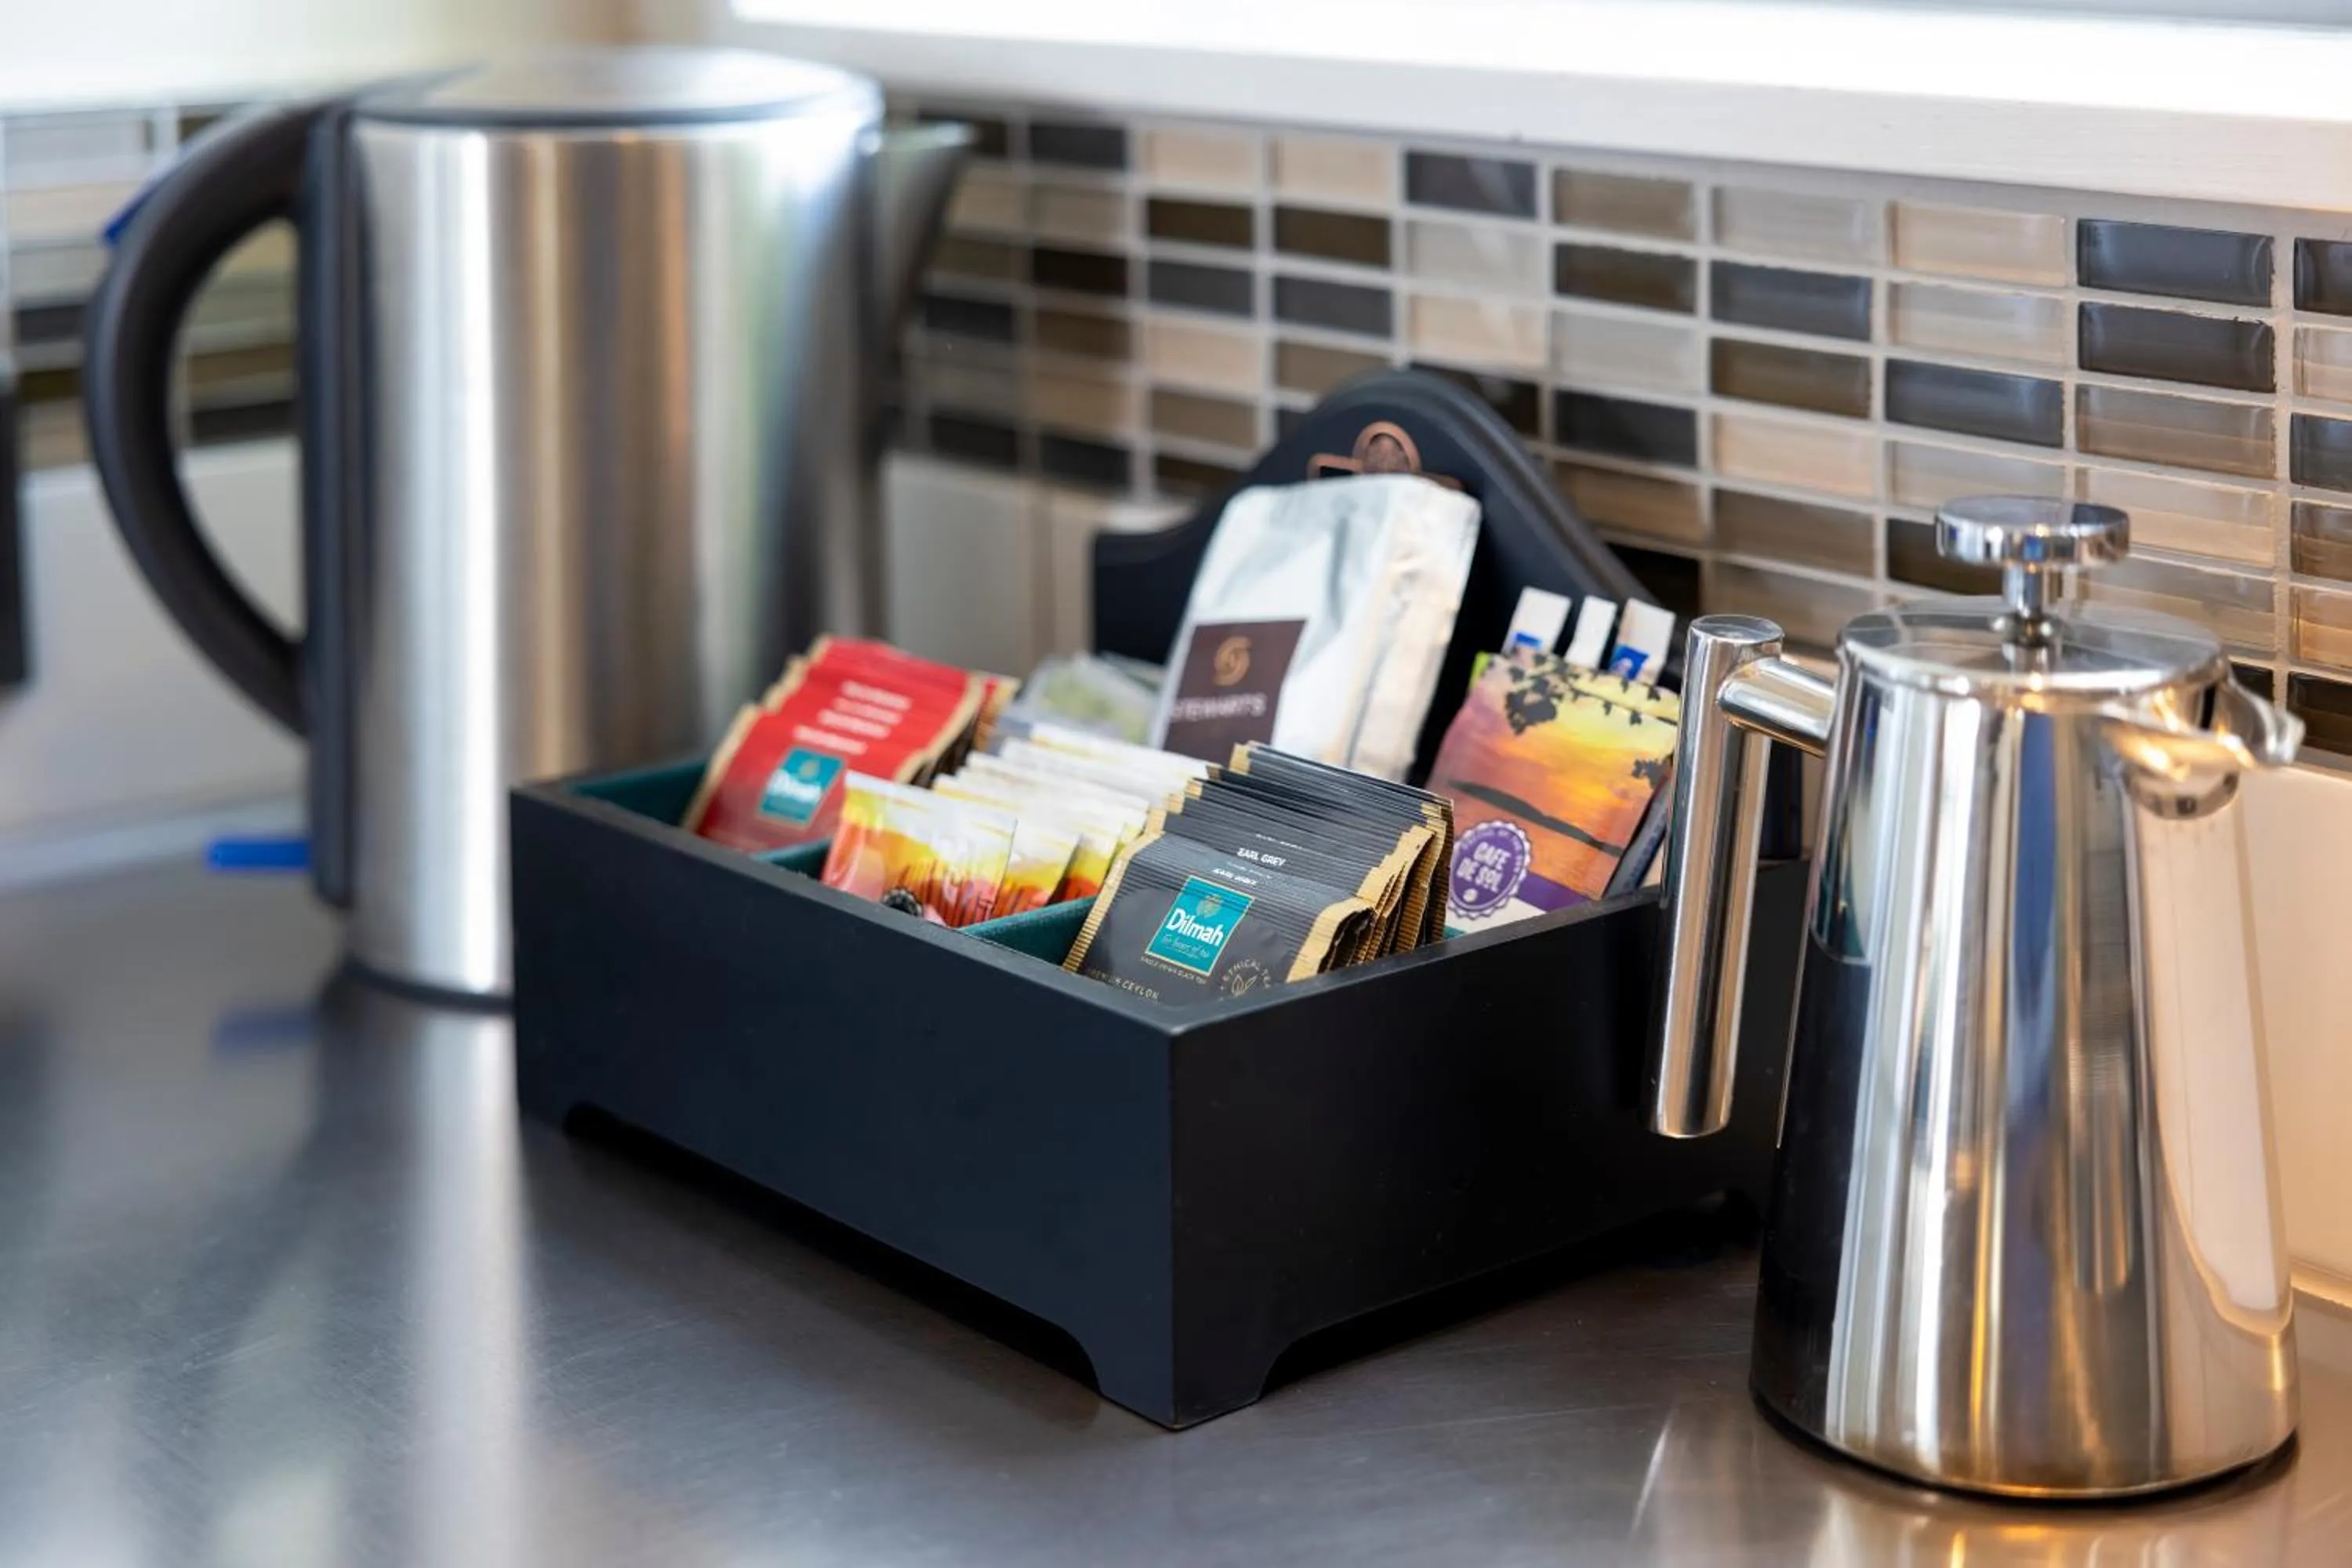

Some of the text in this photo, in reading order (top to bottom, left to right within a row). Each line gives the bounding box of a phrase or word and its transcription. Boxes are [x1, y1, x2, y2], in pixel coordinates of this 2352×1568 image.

[1237, 848, 1287, 866] EARL GREY
[1165, 907, 1224, 947] Dilmah
